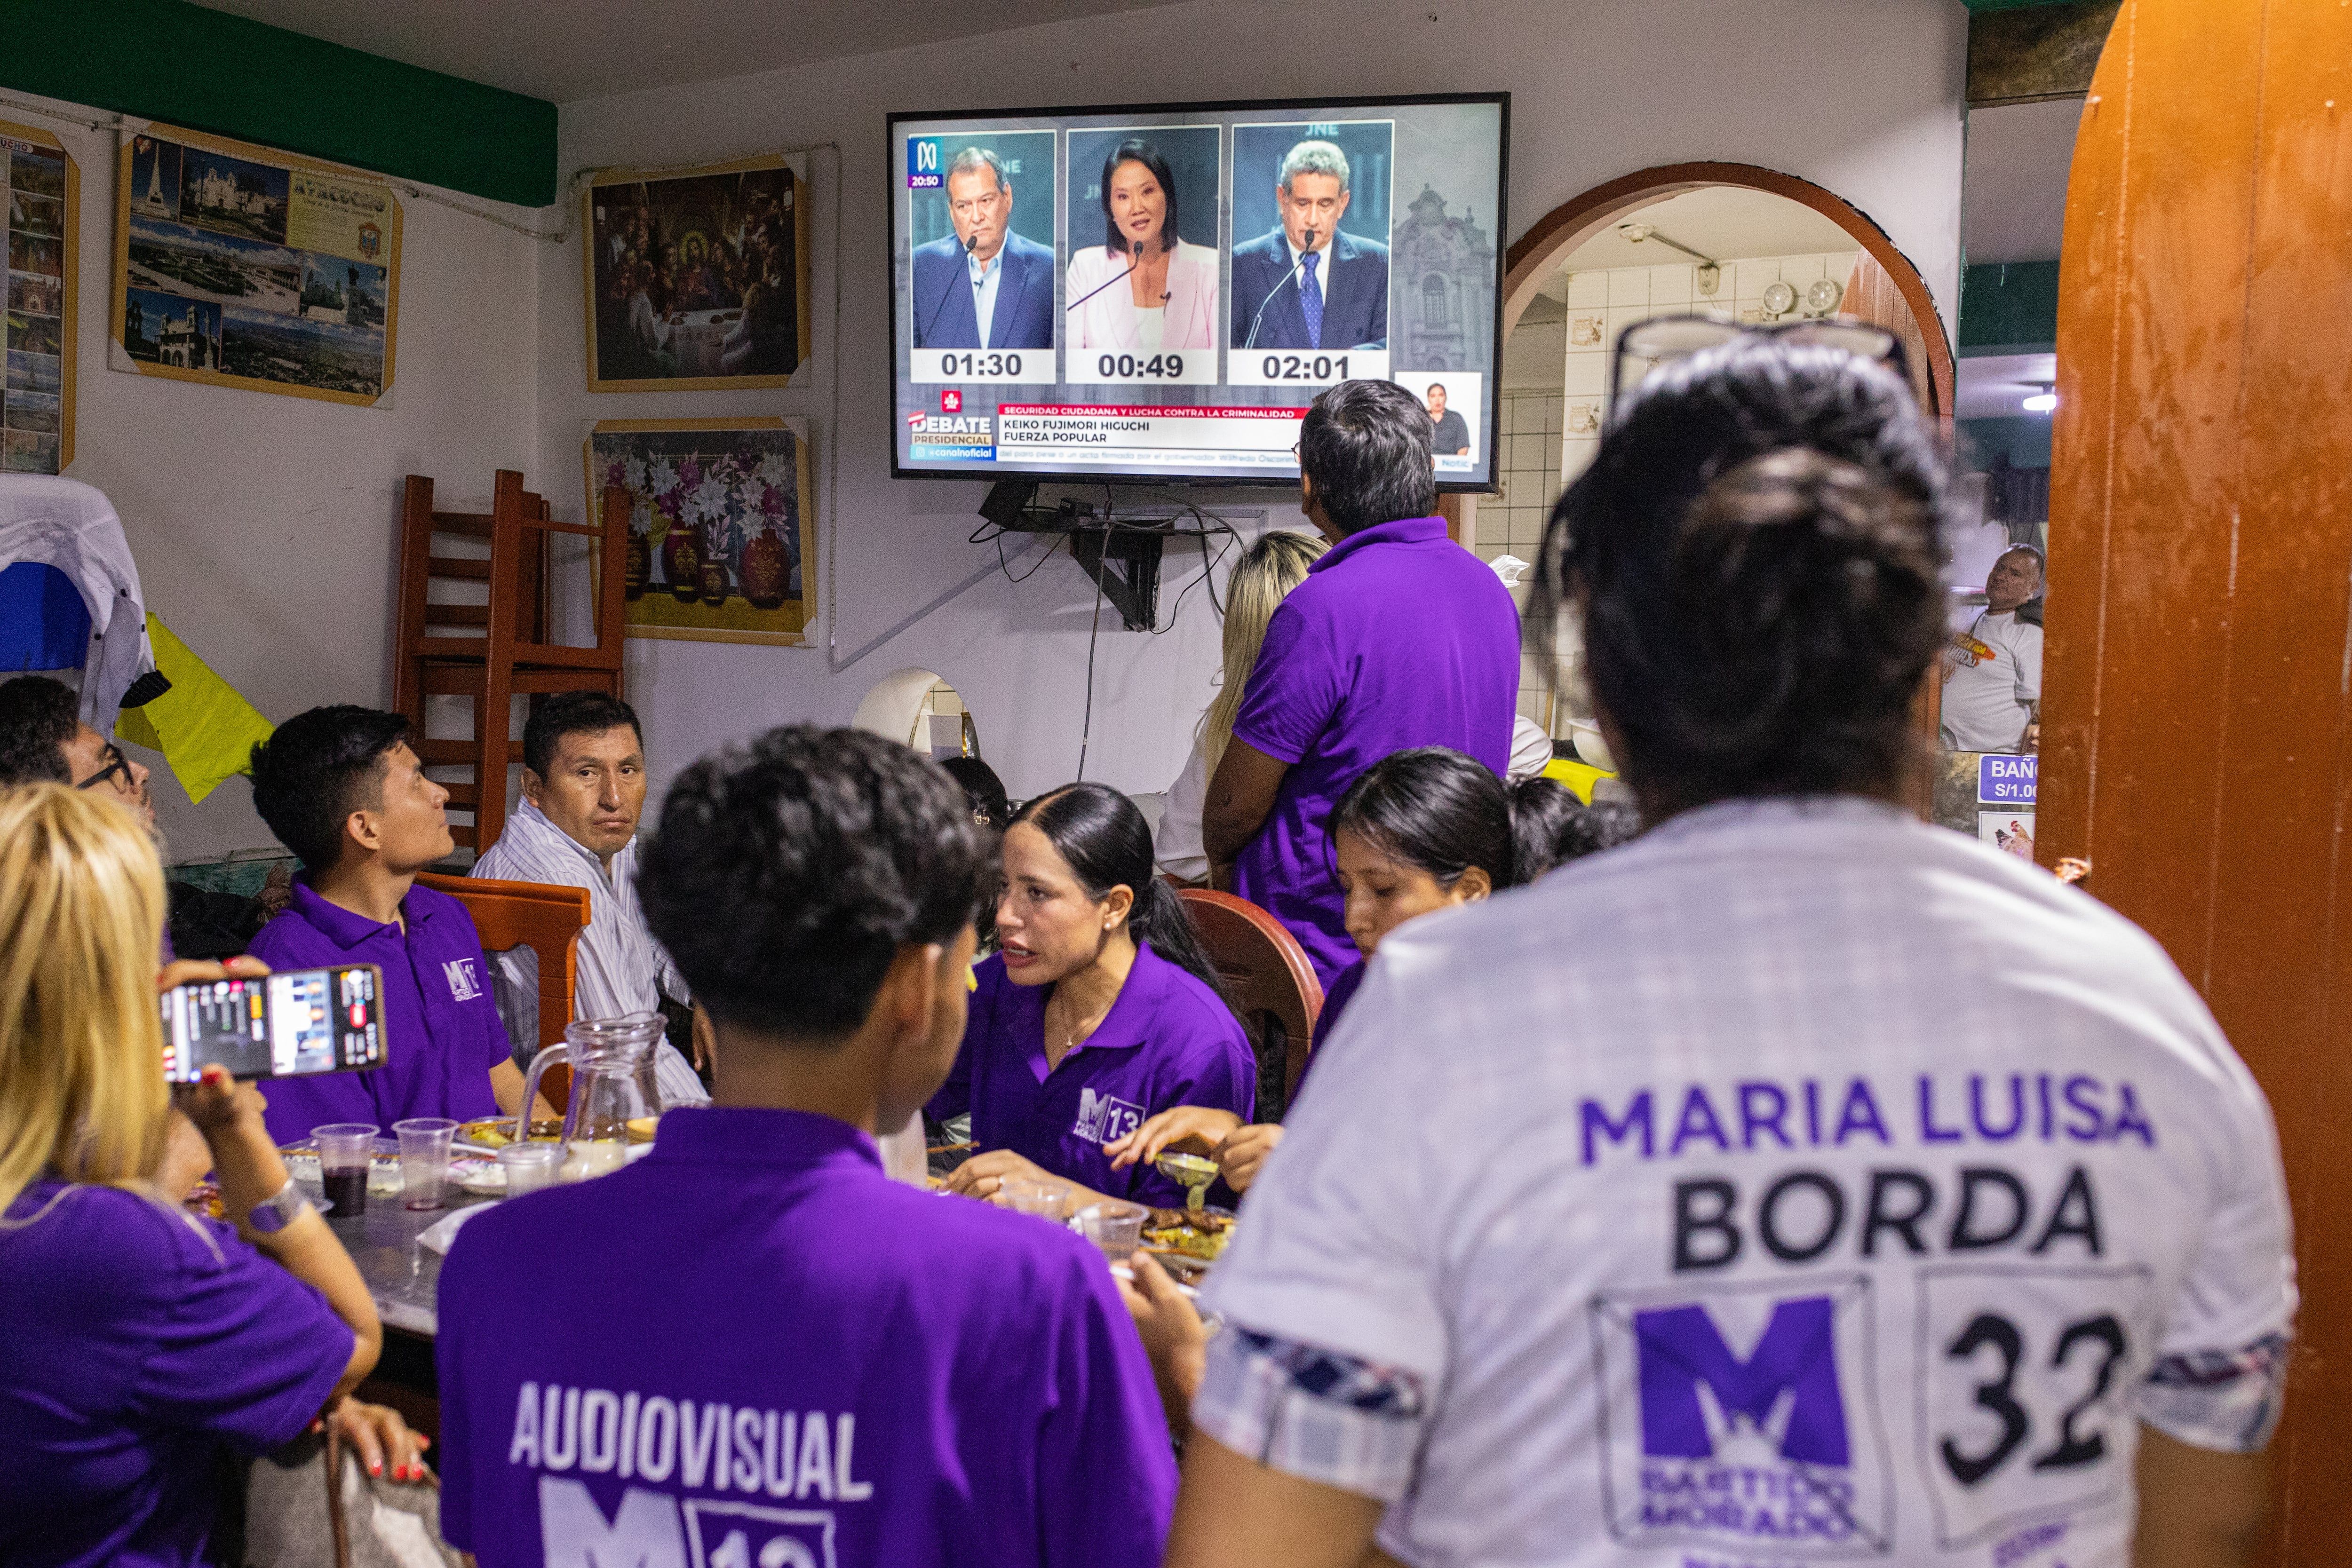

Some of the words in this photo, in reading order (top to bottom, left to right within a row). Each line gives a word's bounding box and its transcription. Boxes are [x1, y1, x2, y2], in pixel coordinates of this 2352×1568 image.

[1305, 124, 1339, 136] JNE
[0, 139, 28, 151] UCHO
[1001, 159, 1021, 174] NE
[912, 176, 938, 187] 20:50
[941, 353, 1022, 376] 01:30
[1098, 354, 1184, 378] 00:49
[1263, 356, 1350, 380] 02:01
[1004, 406, 1058, 415] SEGURIDAD
[1061, 407, 1118, 416] CIUDADANA
[1129, 408, 1162, 417] LUCHA
[1164, 409, 1205, 417] CONTRA
[1222, 410, 1295, 418] CRIMINALIDAD
[911, 416, 991, 433] DEBATE
[1004, 420, 1039, 429] KEIKO
[1043, 420, 1097, 430] FUJIMORI
[1101, 421, 1150, 431] HIGUCHI
[914, 435, 990, 445] PRESIDENCIAL
[1004, 432, 1049, 442] FUERZA
[1053, 433, 1106, 443] POPULAR
[1991, 757, 2038, 778] BAÑ
[1110, 1107, 1139, 1139] 13
[1576, 1076, 1893, 1167] MARIA
[1915, 1072, 2157, 1150] LUISA
[1671, 1162, 2104, 1275] BORDA
[1633, 1297, 1852, 1468] M
[1938, 1311, 2127, 1493] 32
[509, 1380, 874, 1502] AUDIOVISUAL
